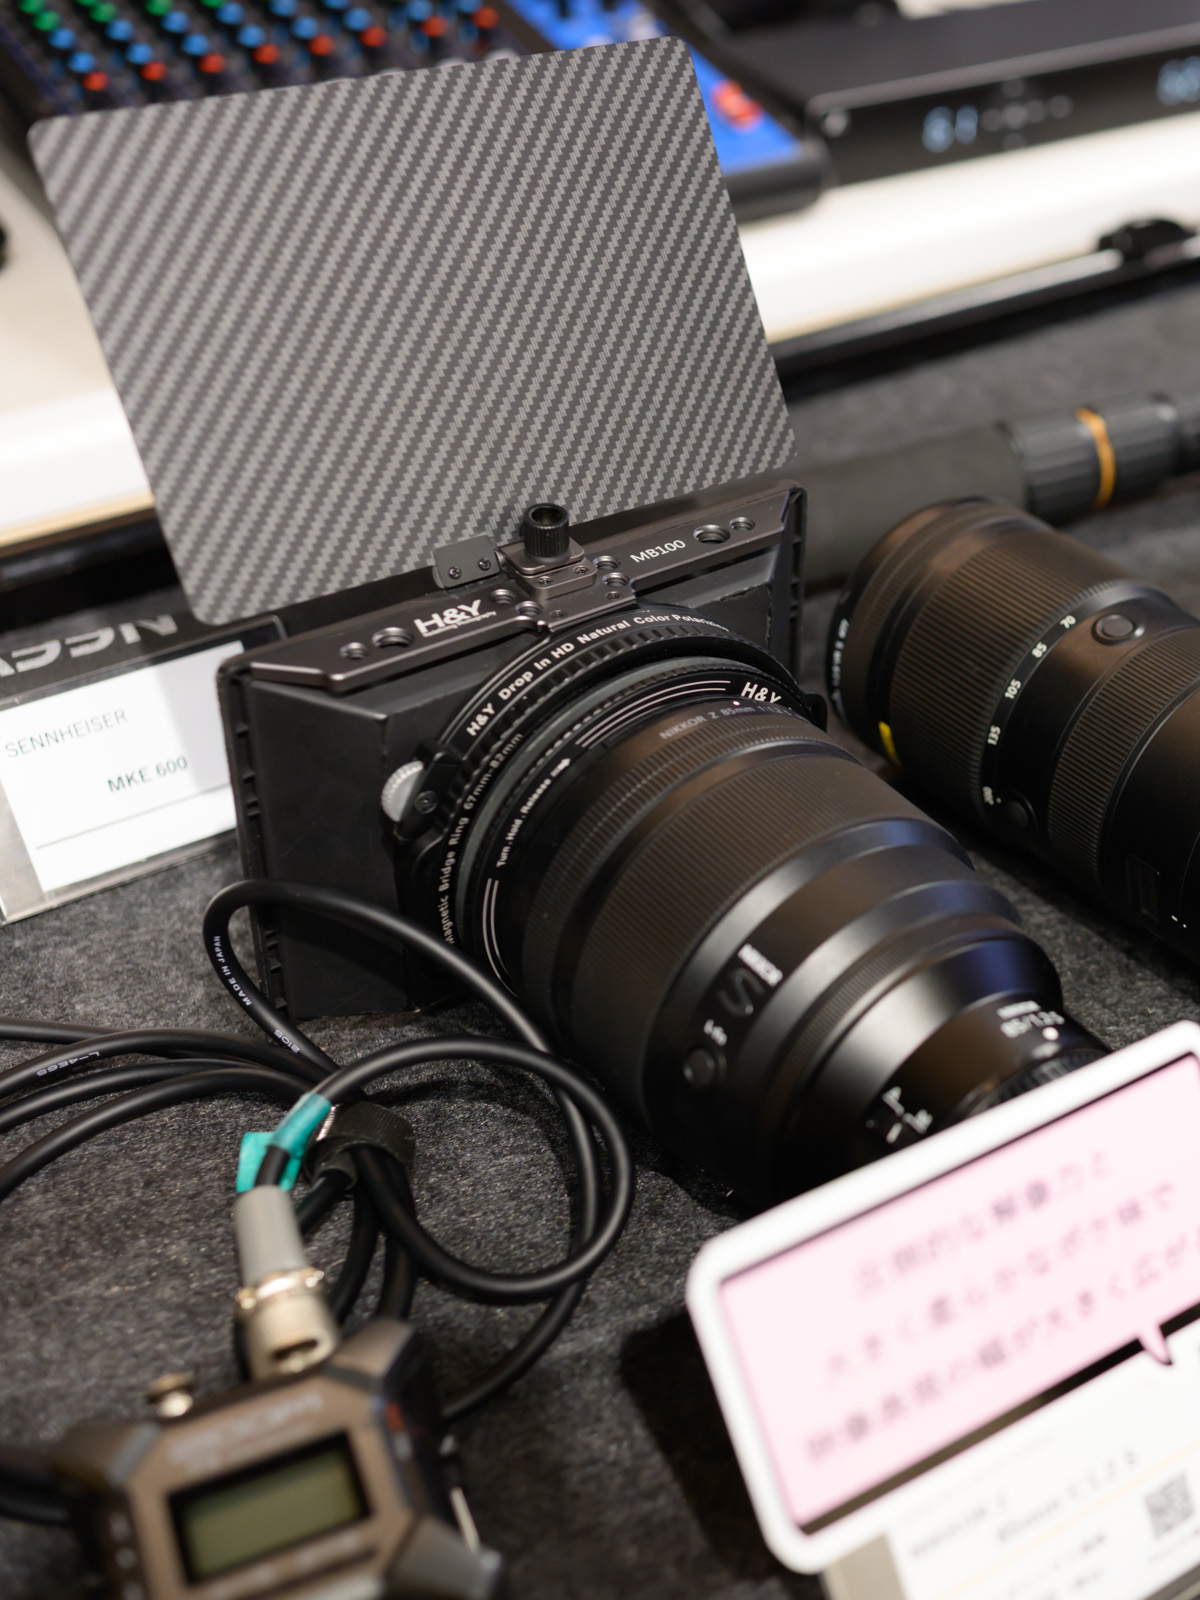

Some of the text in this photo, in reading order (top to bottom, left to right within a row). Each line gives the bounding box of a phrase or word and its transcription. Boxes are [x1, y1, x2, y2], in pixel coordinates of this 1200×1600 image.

[630, 539, 686, 564] MB100
[413, 599, 482, 633] H&Y
[1060, 614, 1077, 629] 70
[1031, 642, 1047, 658] 85
[466, 704, 497, 737] H&Y
[498, 668, 535, 700] Drop
[537, 655, 552, 671] In
[551, 642, 575, 659] HD
[577, 620, 631, 644] Natural
[633, 614, 670, 625] Color
[741, 681, 782, 704] H&Y
[1004, 679, 1021, 699] 105
[5, 708, 129, 759] SENNHEISER
[659, 715, 707, 740] NIKKOR
[707, 711, 720, 720] Z
[720, 706, 756, 716] 85mm
[987, 725, 1001, 745] 135
[107, 755, 189, 794] MKE 600
[496, 778, 552, 868] Turn Hold Release
[438, 851, 456, 892] Bridge
[448, 816, 470, 846] Ring
[213, 935, 253, 1007] MADE IN JAPAN
[274, 1029, 301, 1053] 2105
